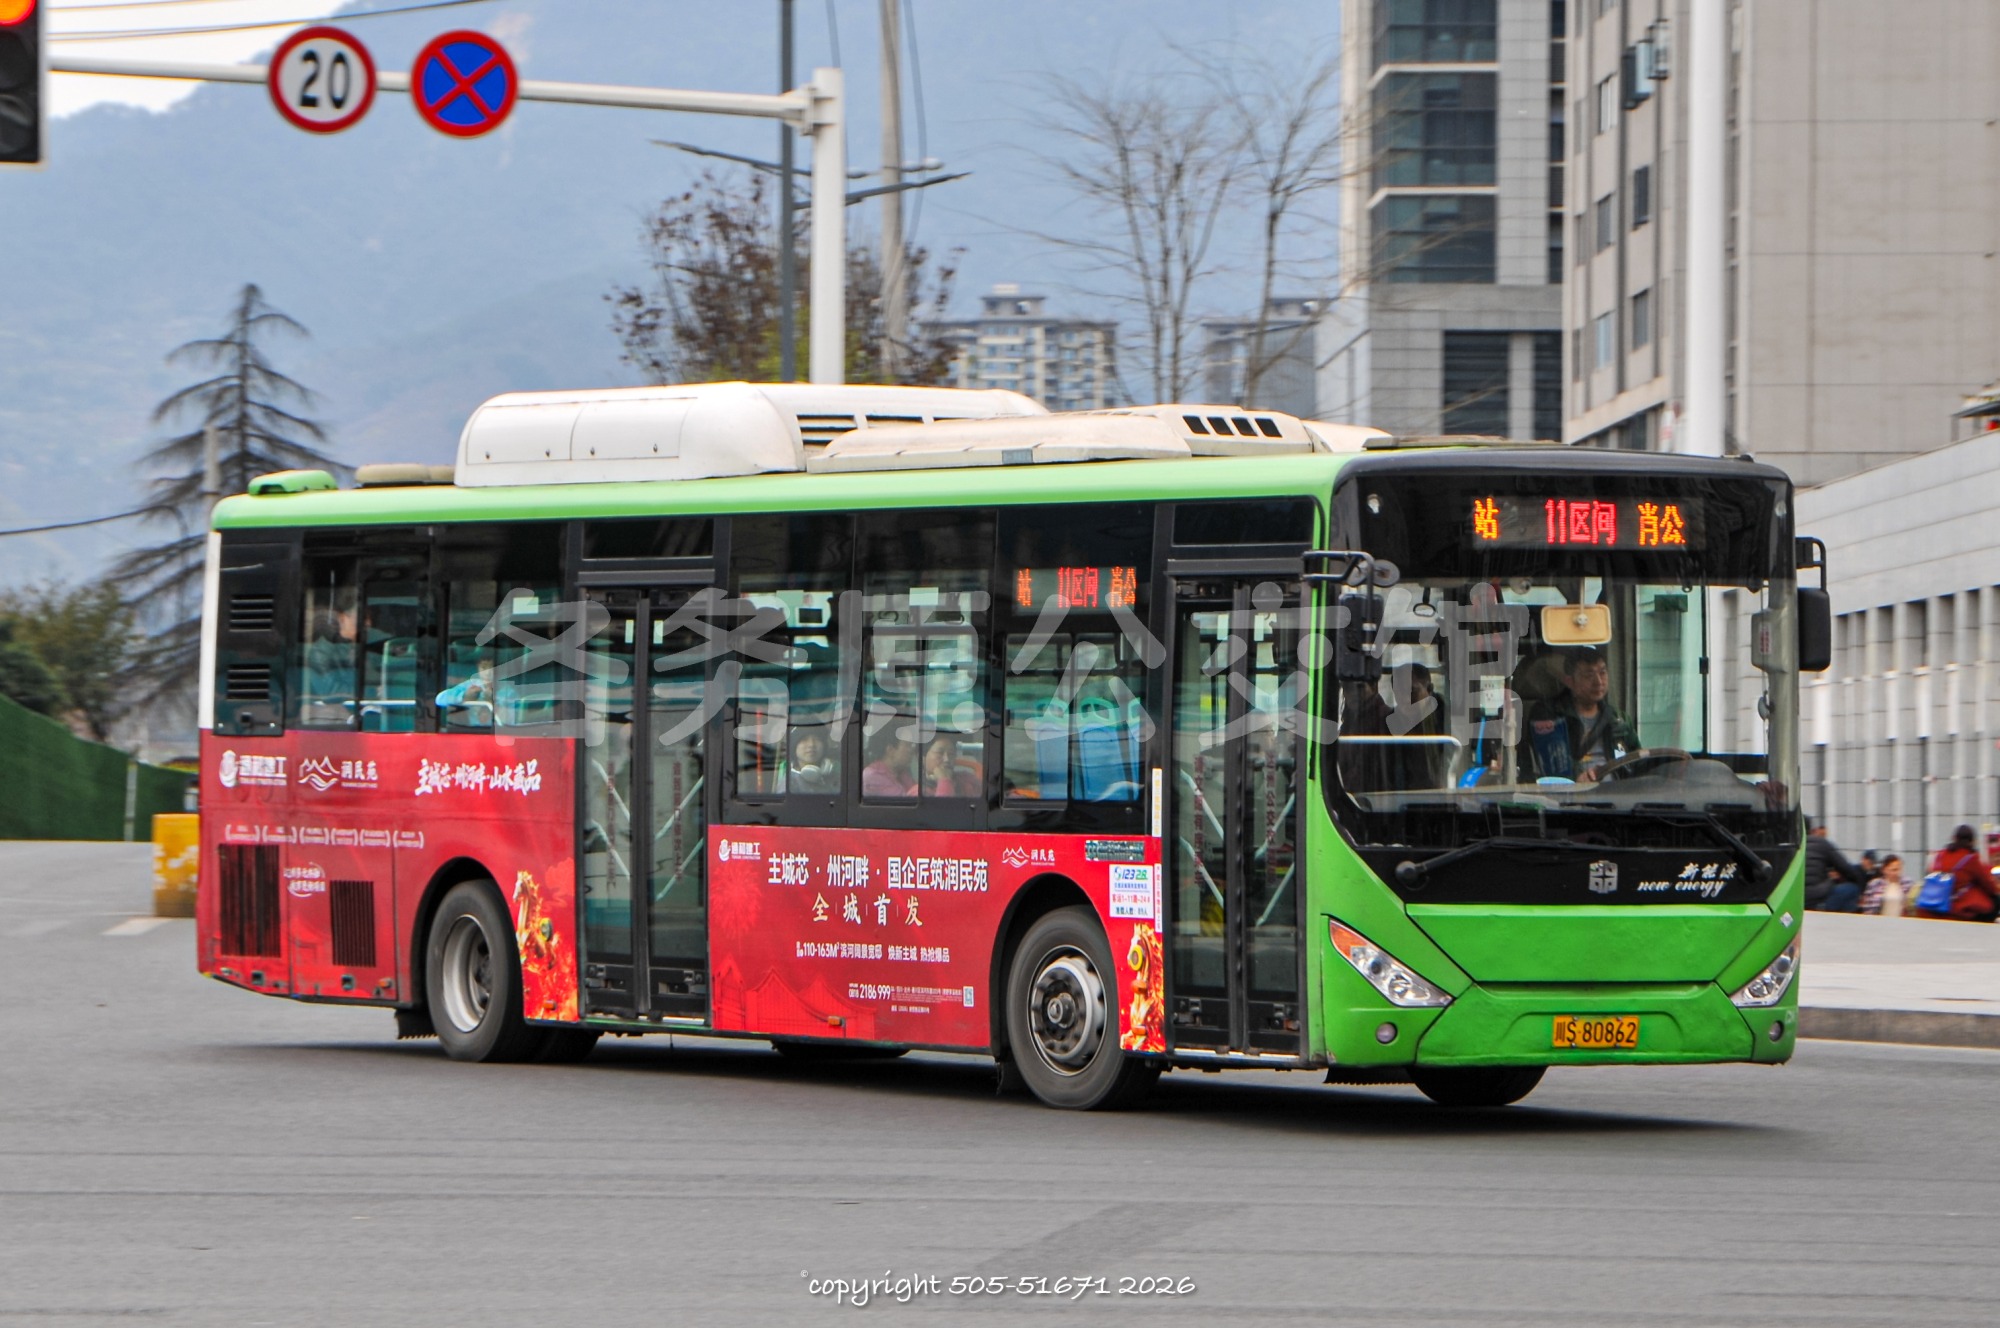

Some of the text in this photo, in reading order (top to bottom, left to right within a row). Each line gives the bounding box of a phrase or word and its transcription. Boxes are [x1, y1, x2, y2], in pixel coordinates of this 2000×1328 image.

[300, 49, 350, 109] 20
[1474, 498, 1686, 546] 站 11区间 肖公
[1016, 566, 1137, 608] 站 11区间 肖公
[1637, 880, 1727, 898] new energy
[860, 984, 877, 1000] 2186
[877, 985, 891, 1000] 999
